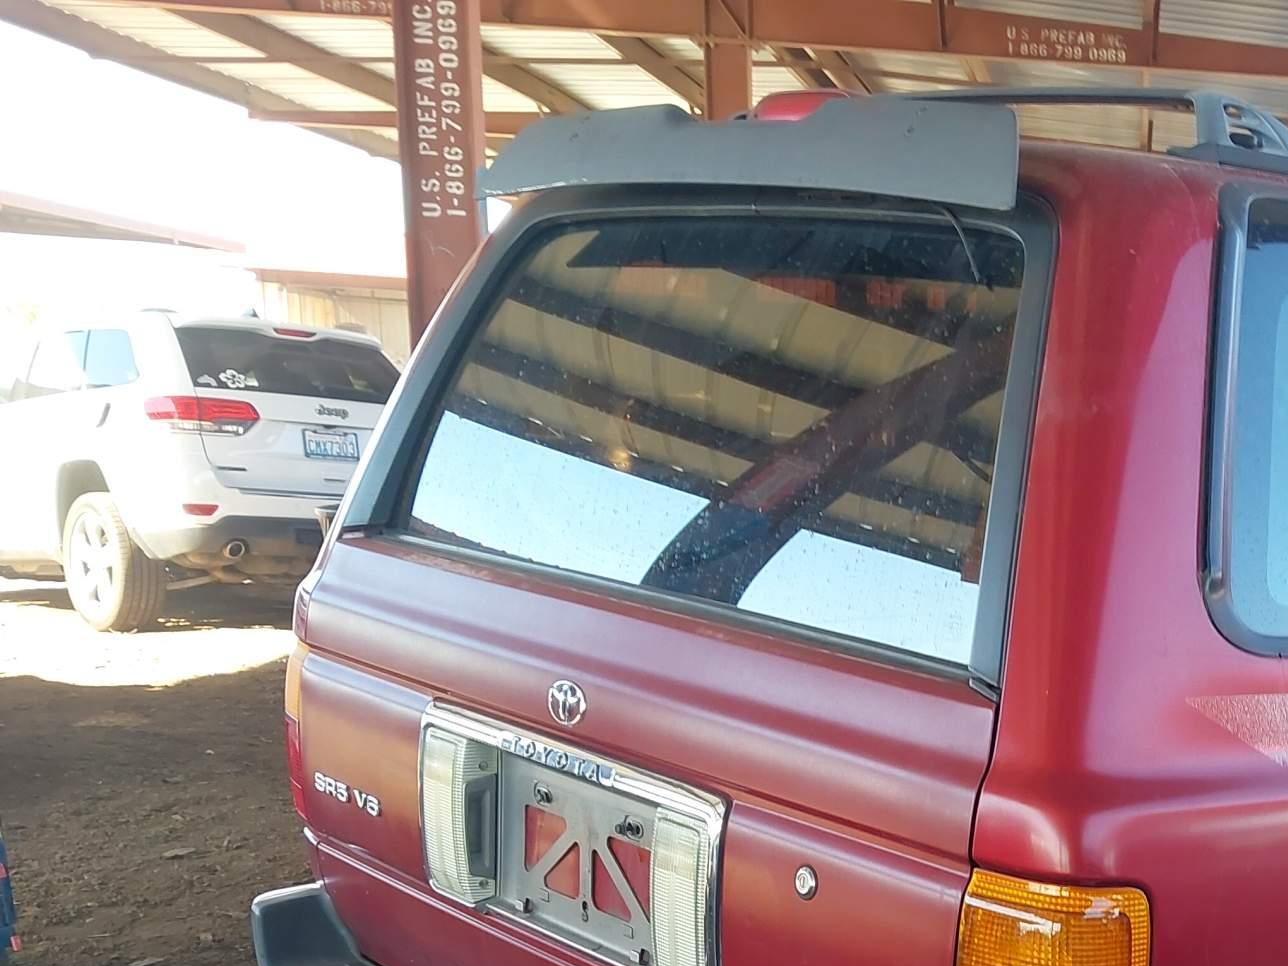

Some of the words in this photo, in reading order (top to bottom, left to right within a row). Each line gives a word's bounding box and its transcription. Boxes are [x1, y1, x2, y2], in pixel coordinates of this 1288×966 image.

[414, 58, 439, 156] PREFAB
[511, 735, 602, 783] TOYOTA
[313, 770, 350, 804] SR5
[352, 788, 381, 817] V6
